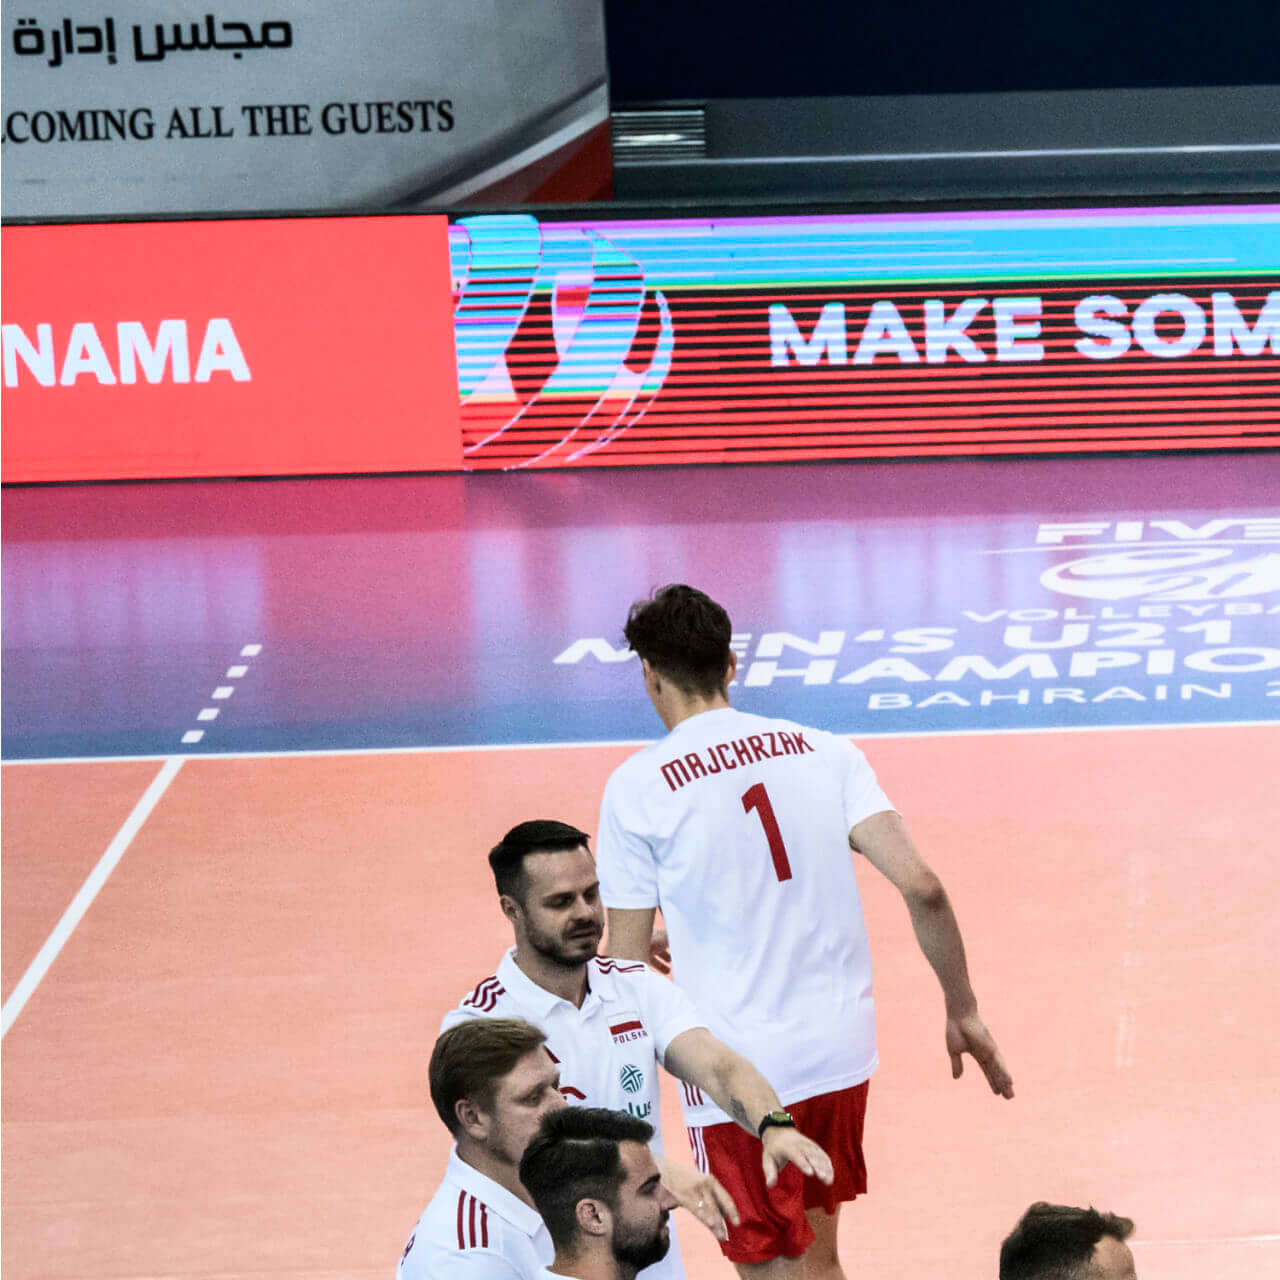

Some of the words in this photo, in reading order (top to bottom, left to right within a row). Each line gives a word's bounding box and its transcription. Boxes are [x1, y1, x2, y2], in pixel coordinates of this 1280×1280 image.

[13, 17, 118, 67] إدارة
[132, 14, 293, 62] مجلس
[0, 108, 154, 143] COMING
[165, 106, 234, 139] ALL
[242, 104, 312, 137] THE
[321, 99, 455, 136] GUESTS
[1, 318, 252, 387] NAMA
[768, 297, 1044, 367] MAKE
[1003, 619, 1232, 650] U21
[868, 681, 1232, 711] BAHRAIN
[660, 731, 816, 793] MAJCHRZAK
[741, 782, 793, 882] 1
